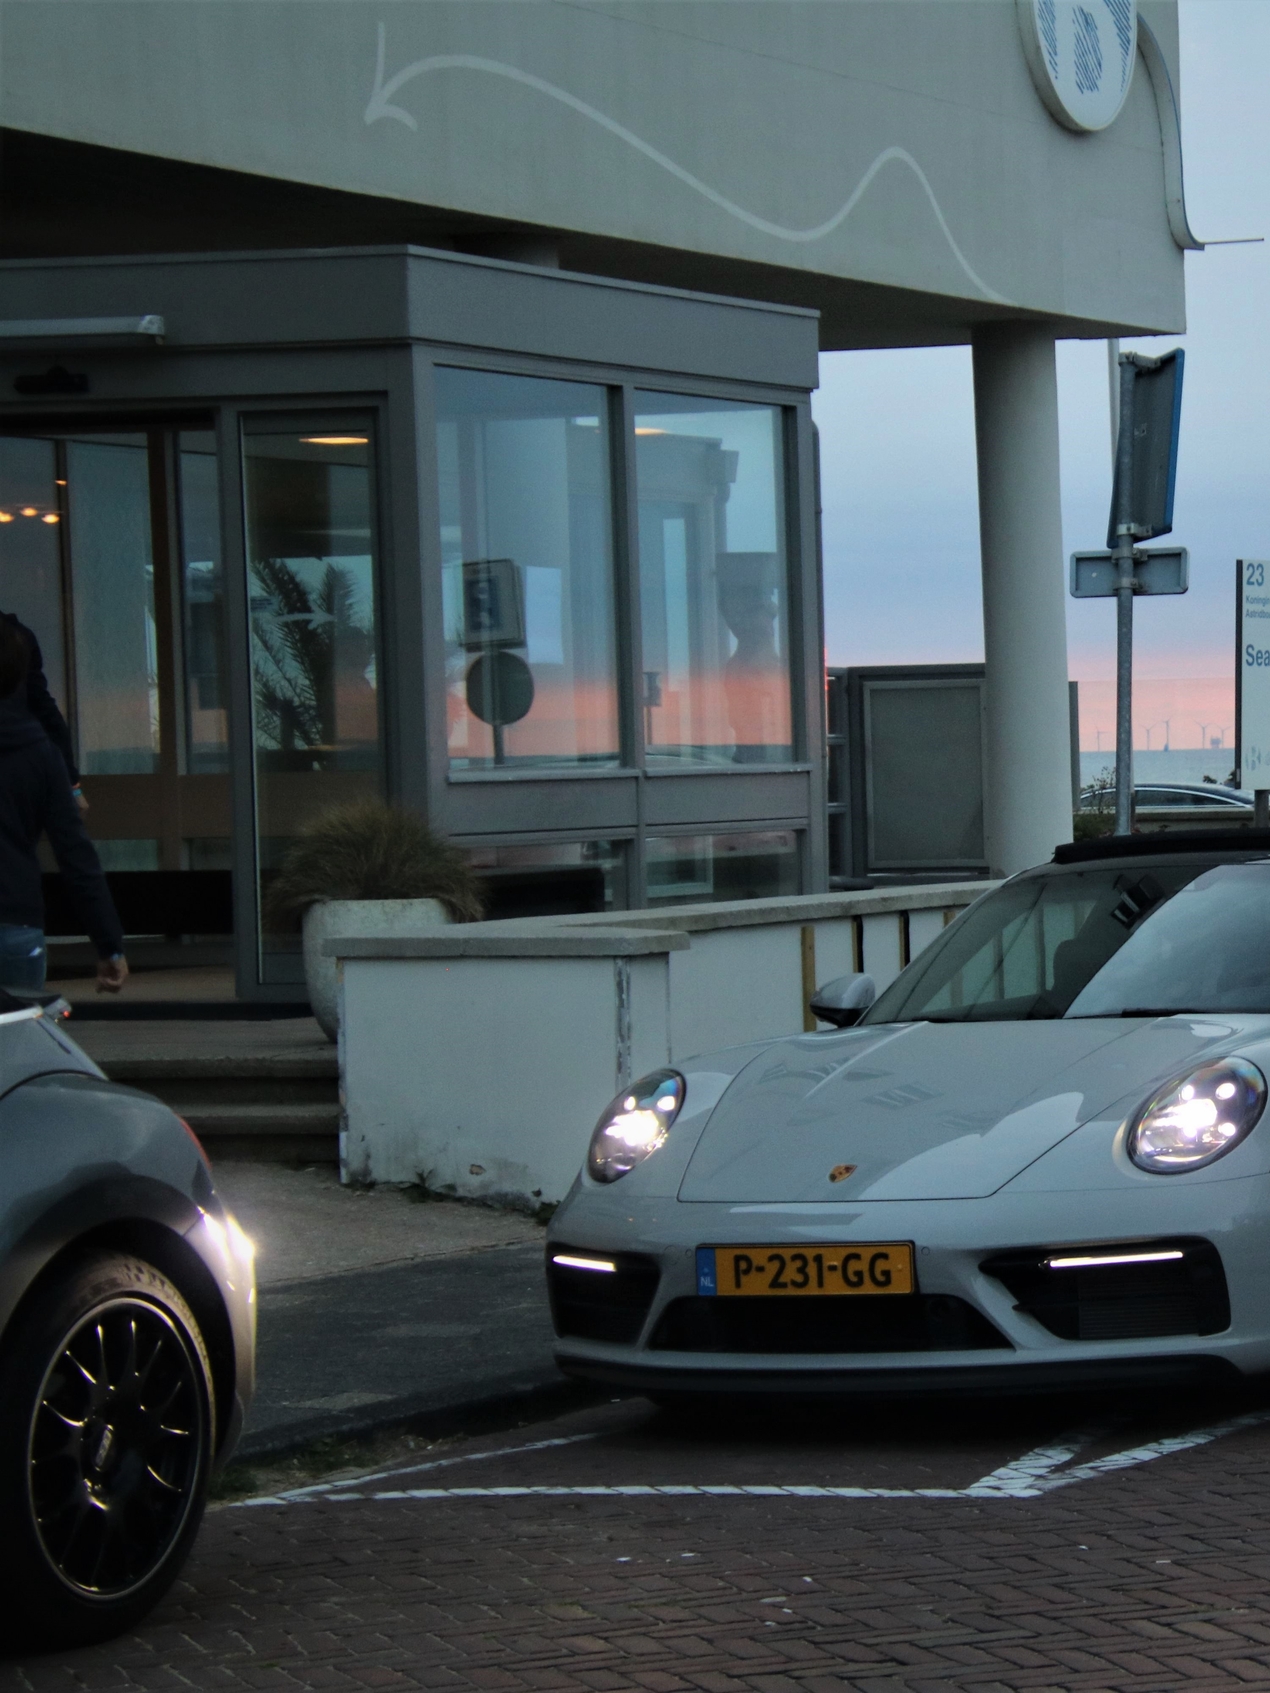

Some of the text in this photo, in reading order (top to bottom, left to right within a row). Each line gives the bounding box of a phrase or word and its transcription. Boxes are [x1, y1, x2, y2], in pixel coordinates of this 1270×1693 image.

[1246, 563, 1265, 587] 23
[1245, 595, 1270, 607] Koningin
[700, 1252, 892, 1289] NL P-231-GG
